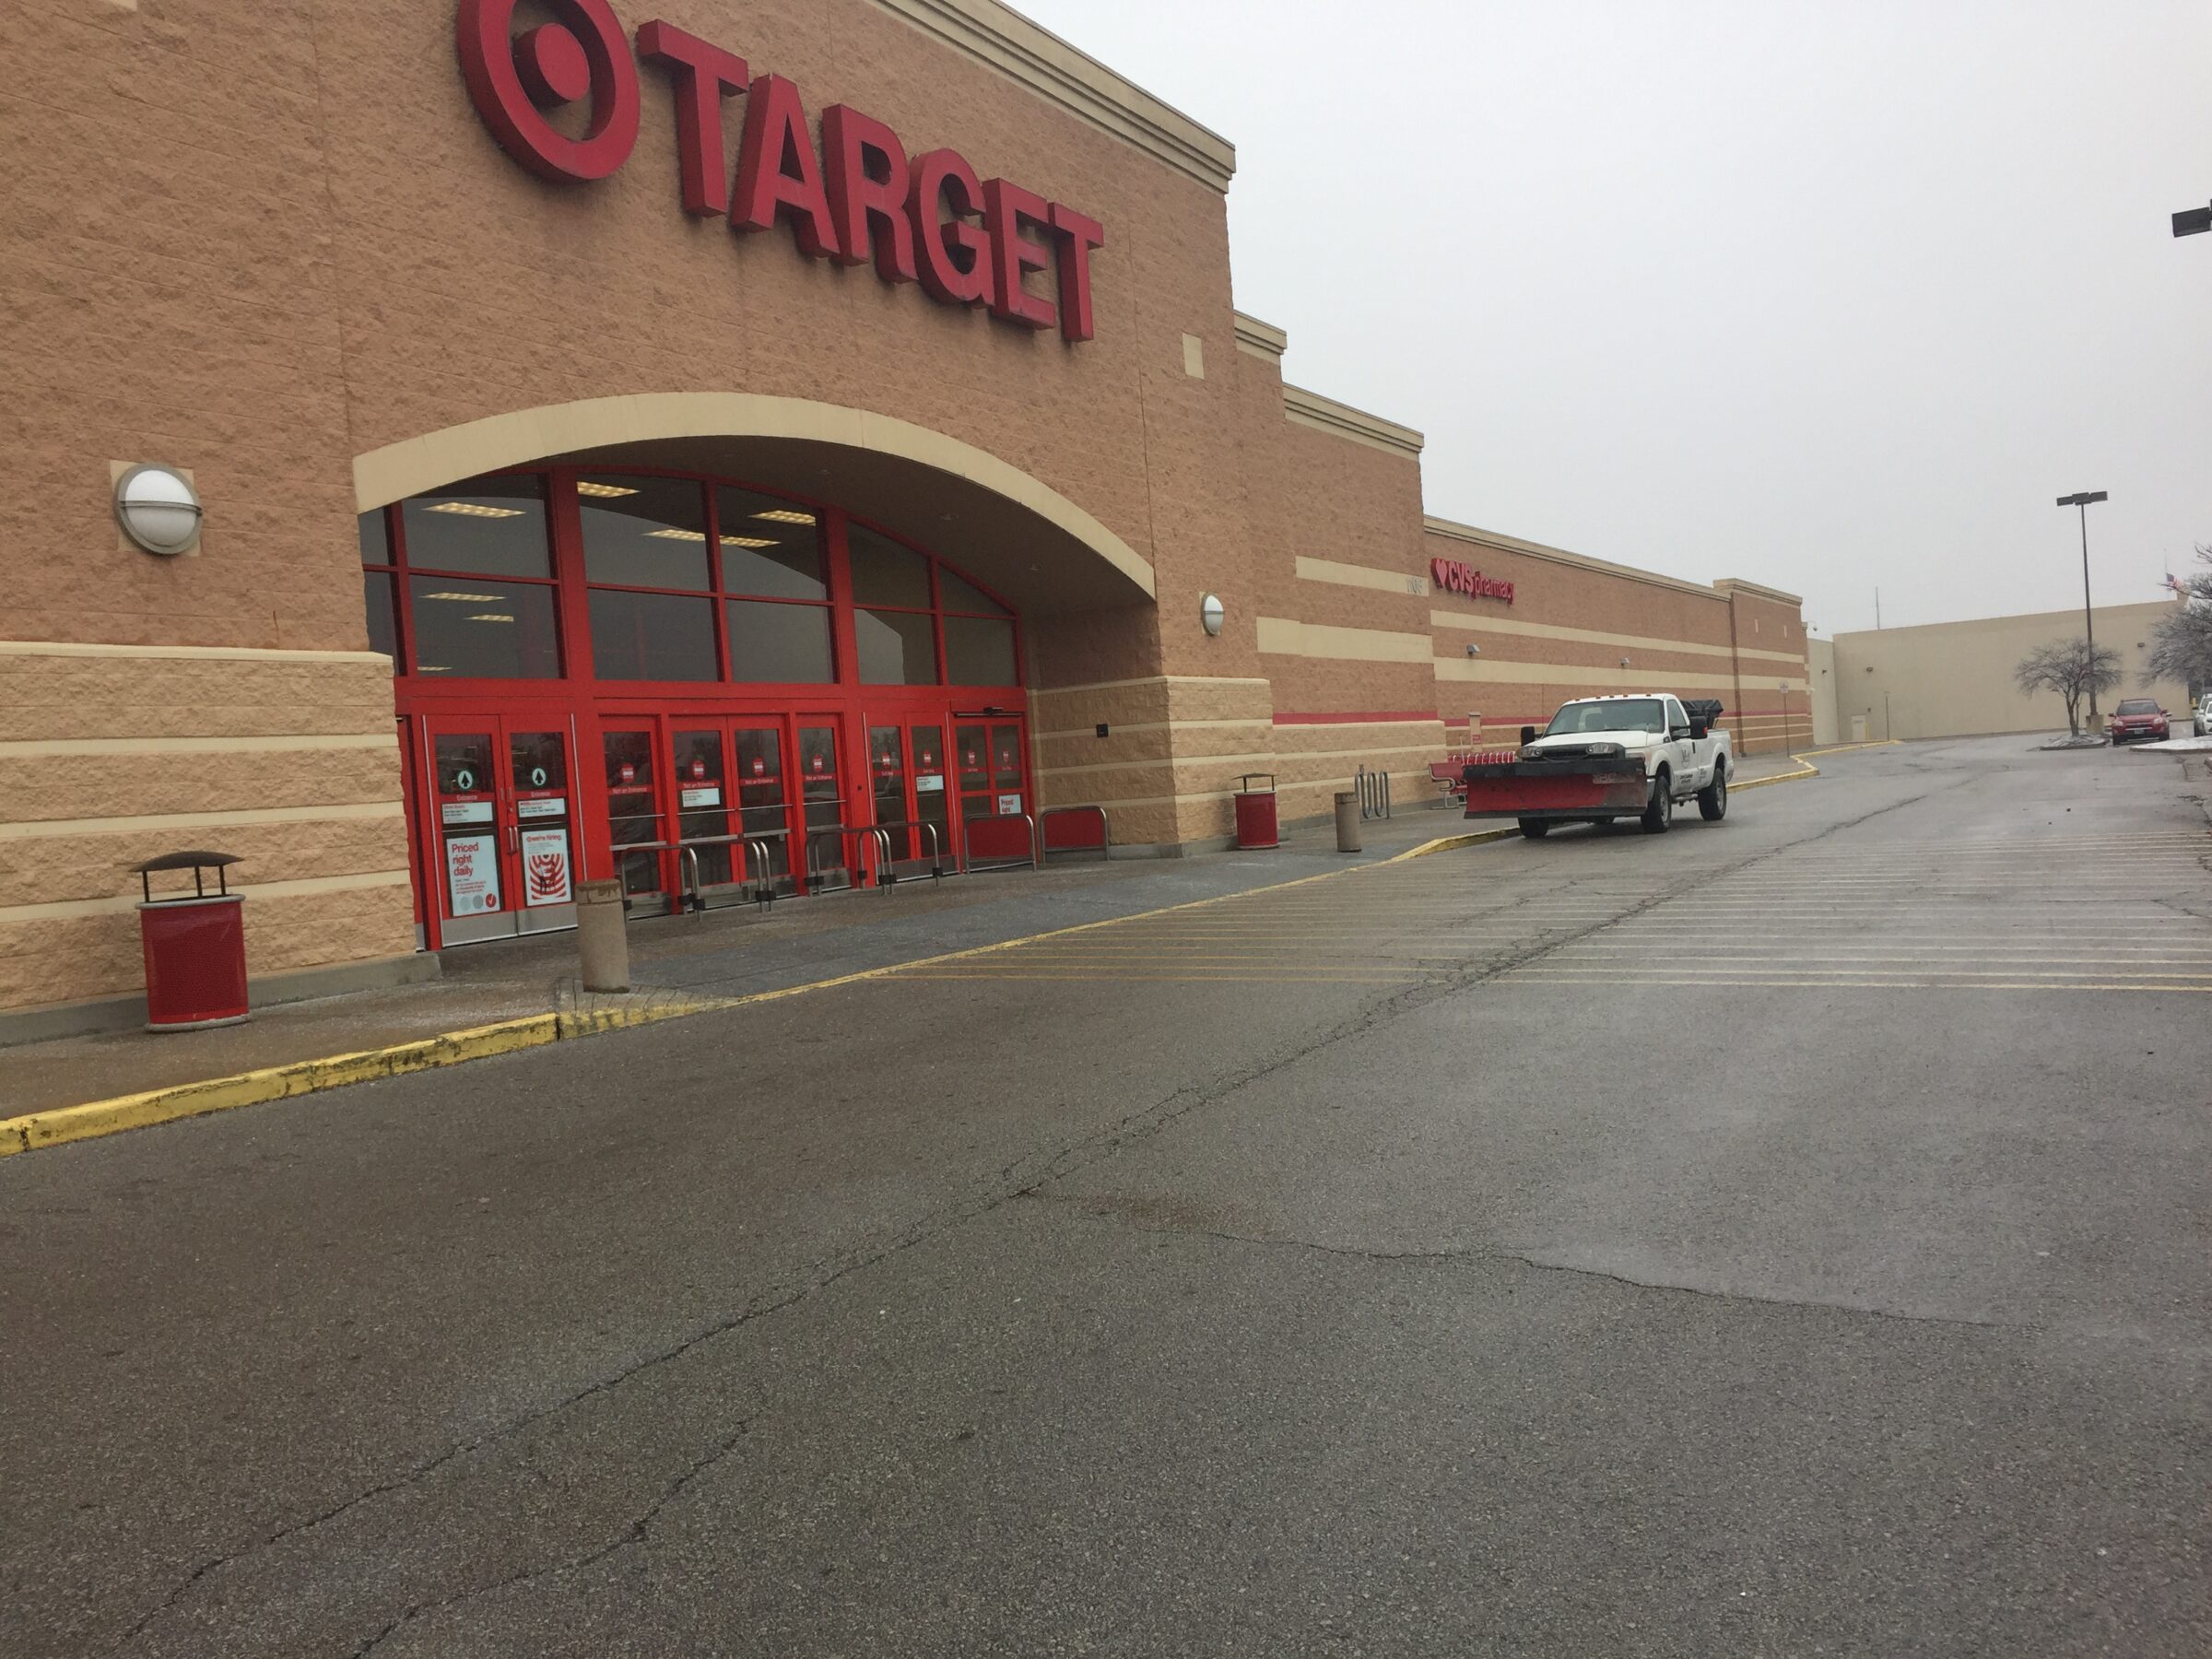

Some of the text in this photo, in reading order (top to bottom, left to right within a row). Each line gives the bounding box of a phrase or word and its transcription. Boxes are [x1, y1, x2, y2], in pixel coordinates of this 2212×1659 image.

[638, 18, 1104, 342] TARGET
[1447, 559, 1475, 594] CVS
[1471, 571, 1514, 606] pharmacy
[452, 841, 479, 853] Priced
[453, 854, 473, 866] right
[453, 865, 473, 877] daily
